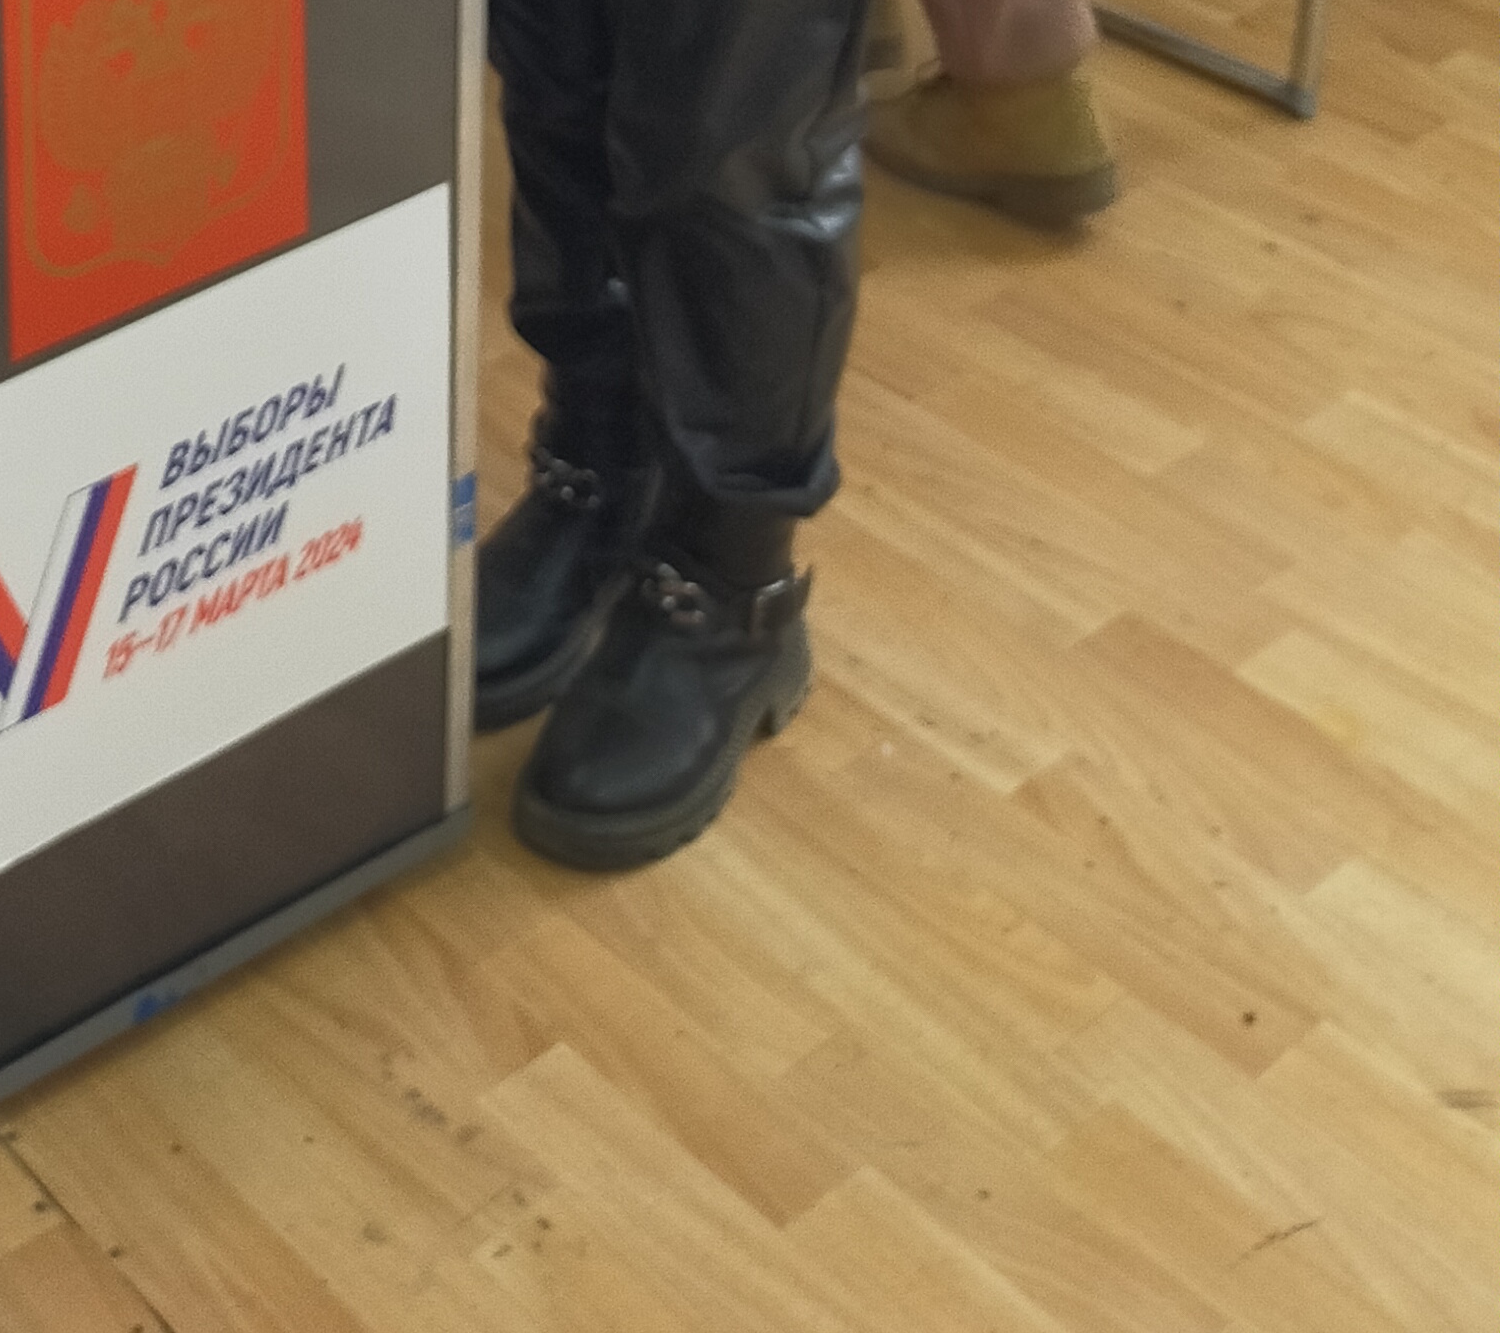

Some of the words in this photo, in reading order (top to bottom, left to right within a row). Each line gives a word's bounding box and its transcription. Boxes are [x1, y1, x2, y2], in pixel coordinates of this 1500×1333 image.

[137, 391, 398, 558] ПРЕЗИДЕНТА
[158, 363, 346, 491] ВЫБОРЫ
[118, 500, 289, 624] РОССИИ
[189, 554, 289, 637] МАРТА
[292, 516, 364, 582] 2024
